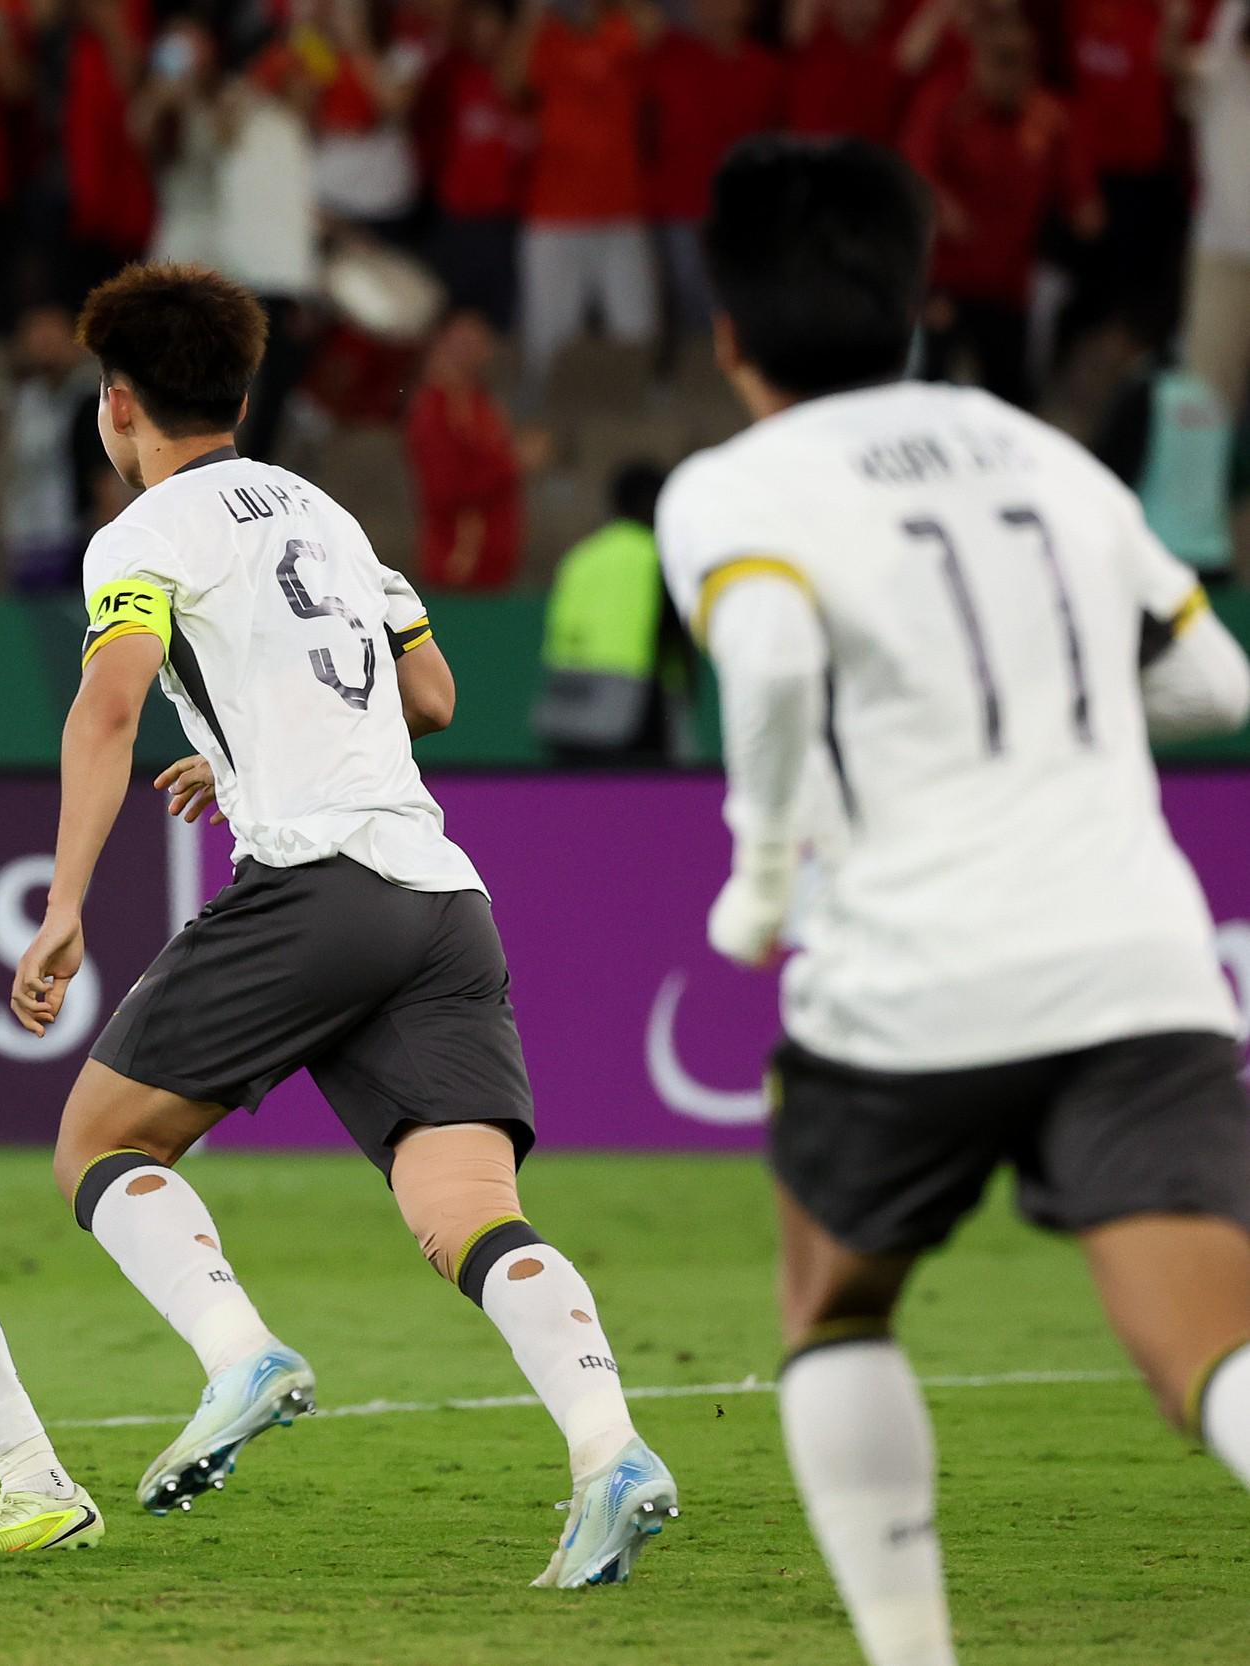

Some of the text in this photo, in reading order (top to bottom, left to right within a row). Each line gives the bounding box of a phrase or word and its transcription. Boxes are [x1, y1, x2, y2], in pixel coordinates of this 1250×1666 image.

[218, 486, 274, 524] LIU
[94, 592, 154, 625] AFC
[276, 538, 376, 711] 5
[900, 506, 1096, 760] 11
